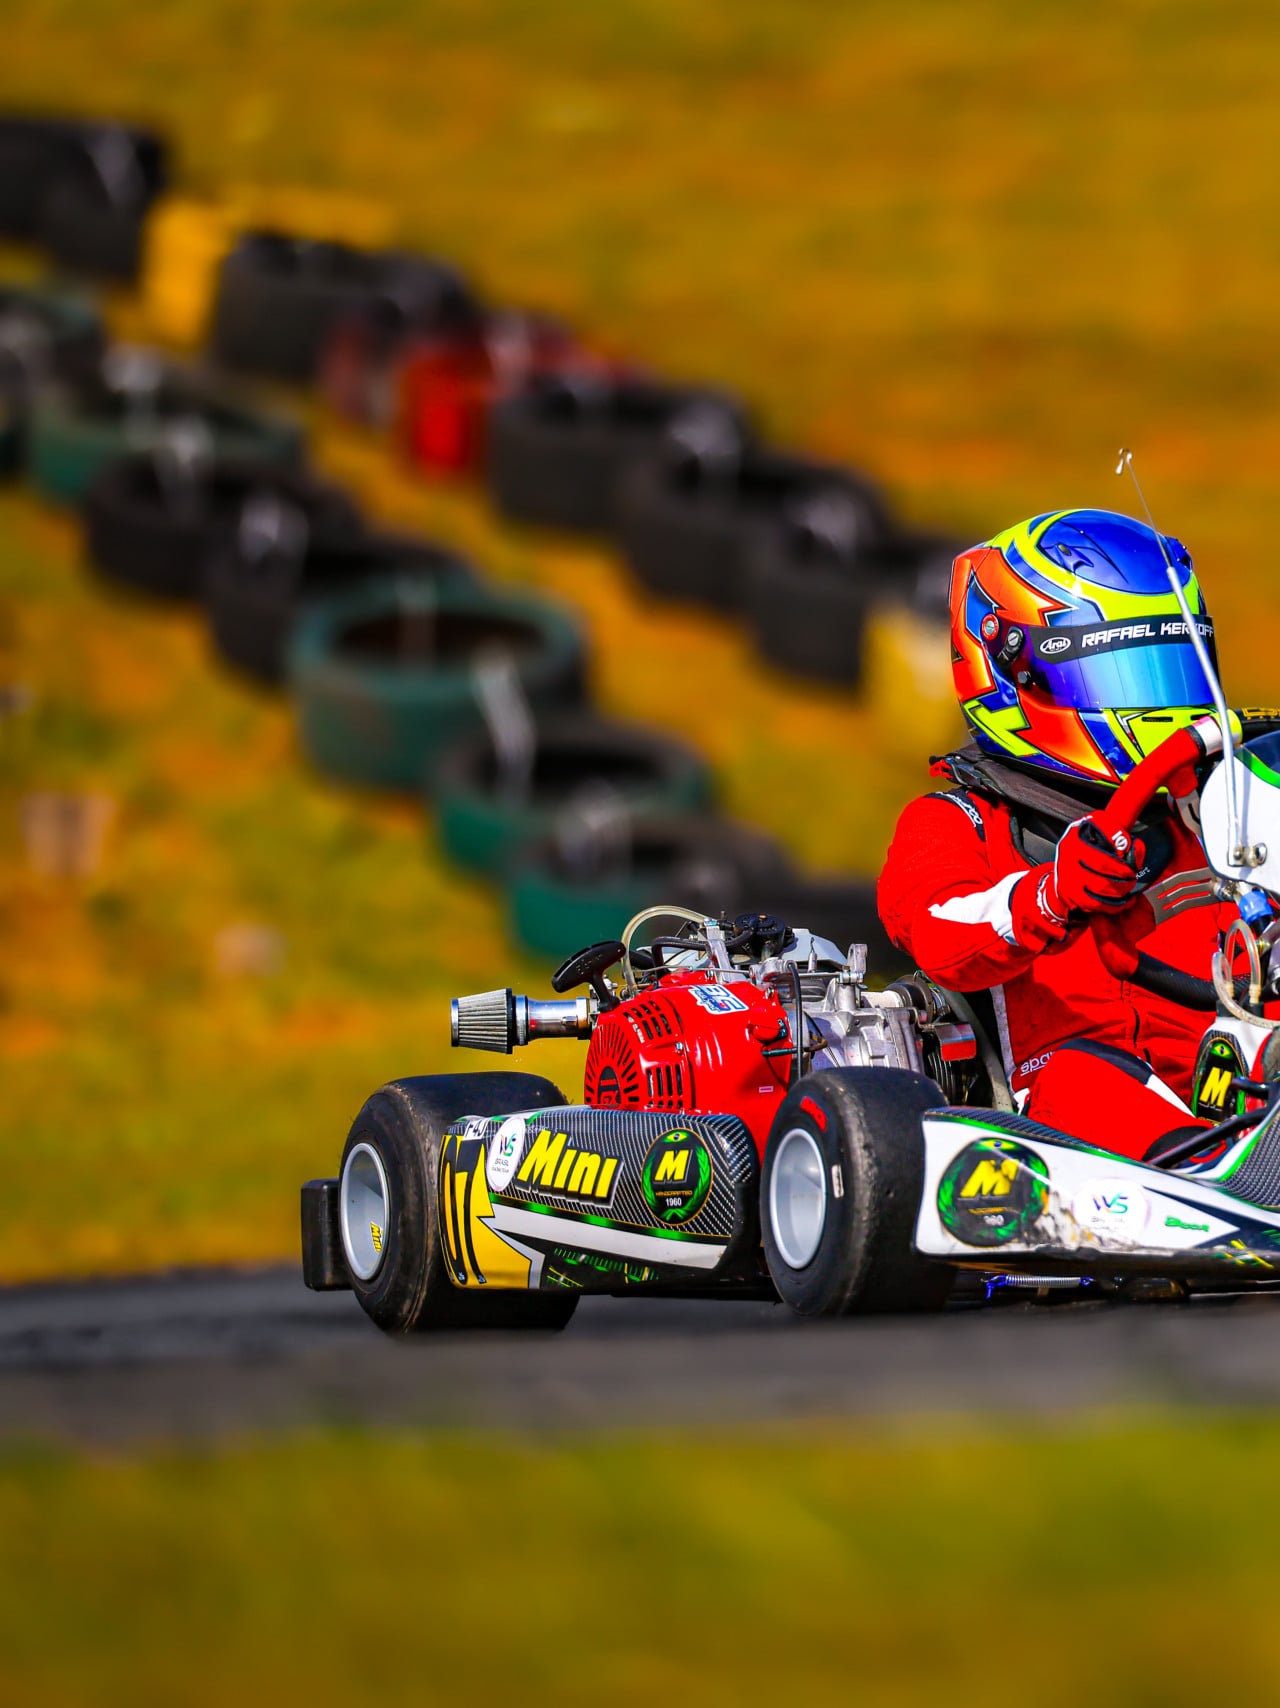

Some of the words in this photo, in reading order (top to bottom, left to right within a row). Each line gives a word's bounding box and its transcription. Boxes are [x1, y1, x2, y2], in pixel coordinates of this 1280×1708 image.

[1081, 623, 1157, 648] RAFAEL
[1160, 621, 1214, 637] KEROFF
[1200, 1066, 1233, 1107] M
[517, 1129, 618, 1198] Mini
[654, 1149, 690, 1181] M
